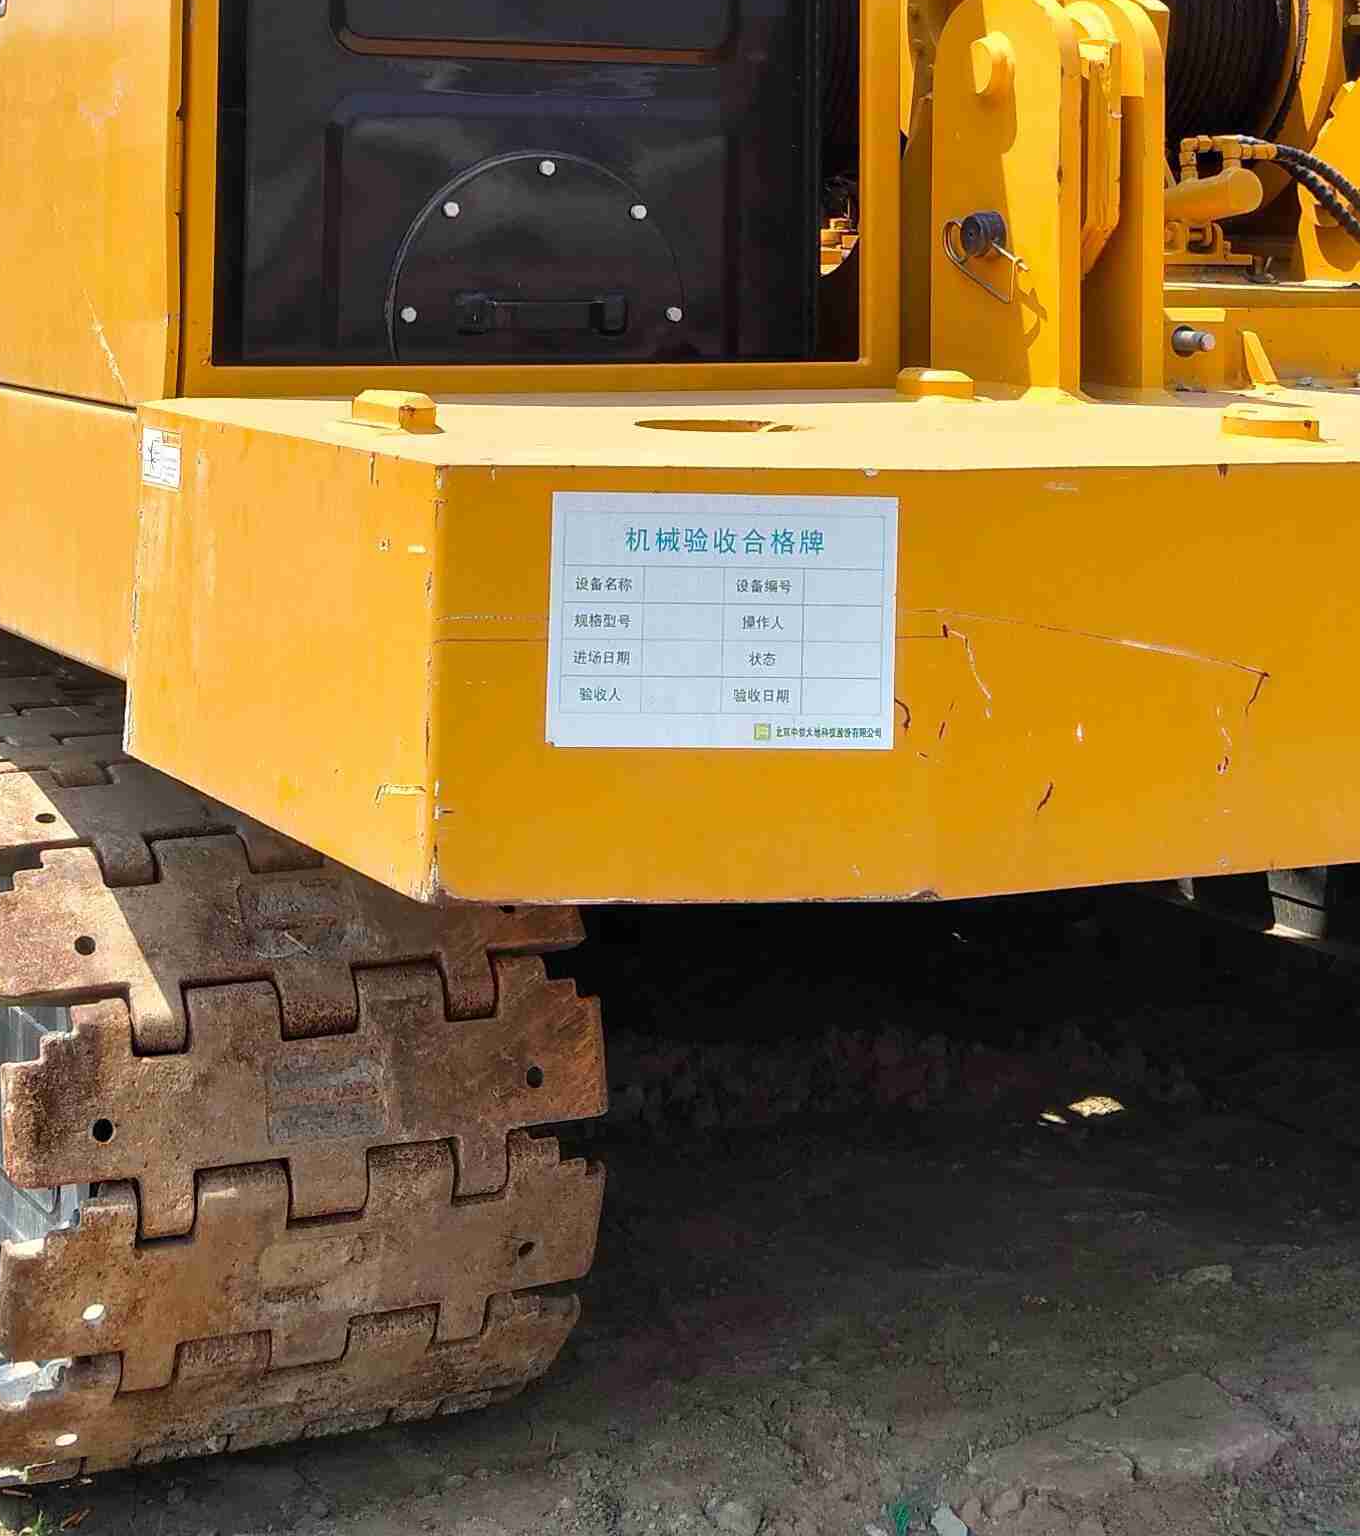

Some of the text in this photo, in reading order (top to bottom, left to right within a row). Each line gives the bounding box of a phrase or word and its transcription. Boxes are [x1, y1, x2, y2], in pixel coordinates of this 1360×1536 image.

[625, 526, 825, 555] 机械验收合格牌
[575, 576, 633, 592] 设备名称
[735, 578, 793, 594] 设备编号
[574, 613, 632, 629] 规格型号
[741, 615, 785, 631] 操作人
[573, 650, 631, 665] 进场日期
[748, 650, 777, 666] 状态
[578, 687, 622, 702] 验收人
[733, 687, 791, 704] 验收日期
